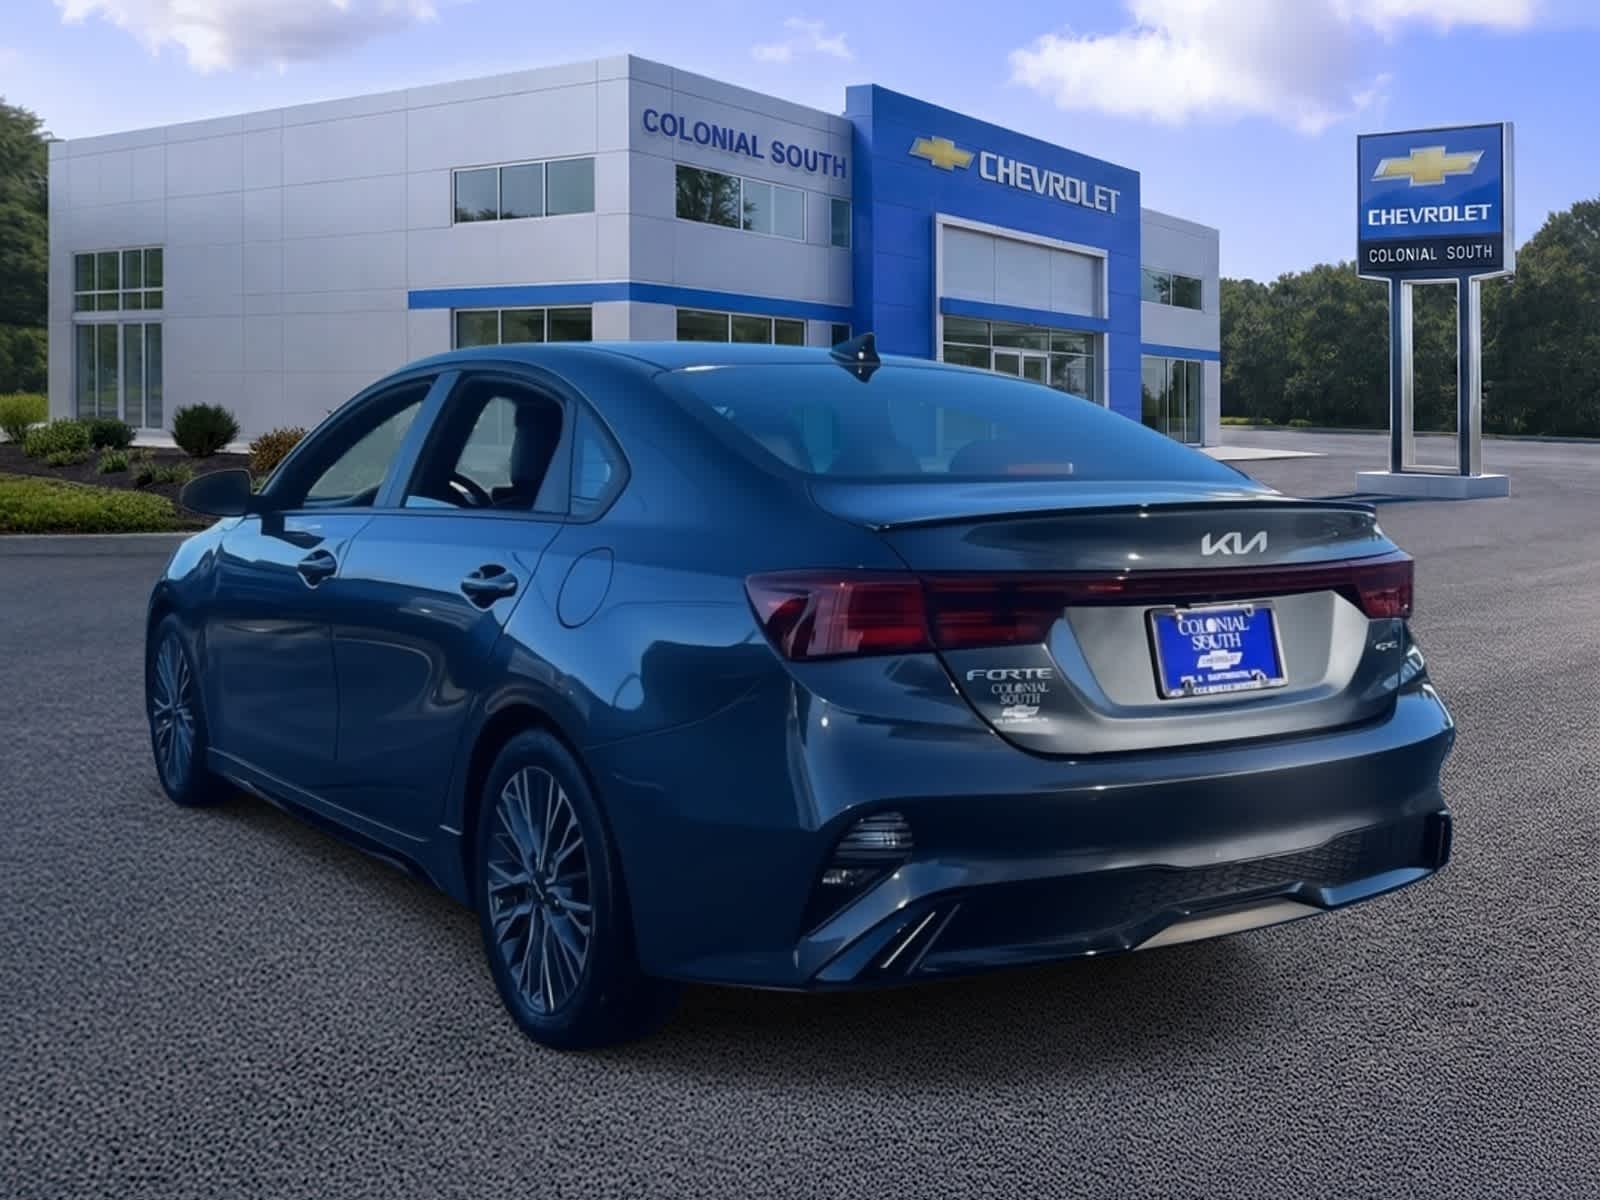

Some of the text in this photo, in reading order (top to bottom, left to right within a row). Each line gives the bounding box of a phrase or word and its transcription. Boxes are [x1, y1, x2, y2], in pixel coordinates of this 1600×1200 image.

[643, 108, 847, 179] COLONIAL SOUTH
[979, 150, 1121, 214] CHEVROLET
[1368, 203, 1492, 226] CHEVROLET
[1369, 244, 1493, 263] COLONIAL SOUTH
[1201, 531, 1268, 556] KIA
[1178, 615, 1250, 636] COLONIAL
[1191, 632, 1242, 651] SOUTH
[966, 667, 1053, 681] FORTE
[991, 681, 1050, 695] COLONIAL
[1000, 693, 1041, 705] SOUTH
